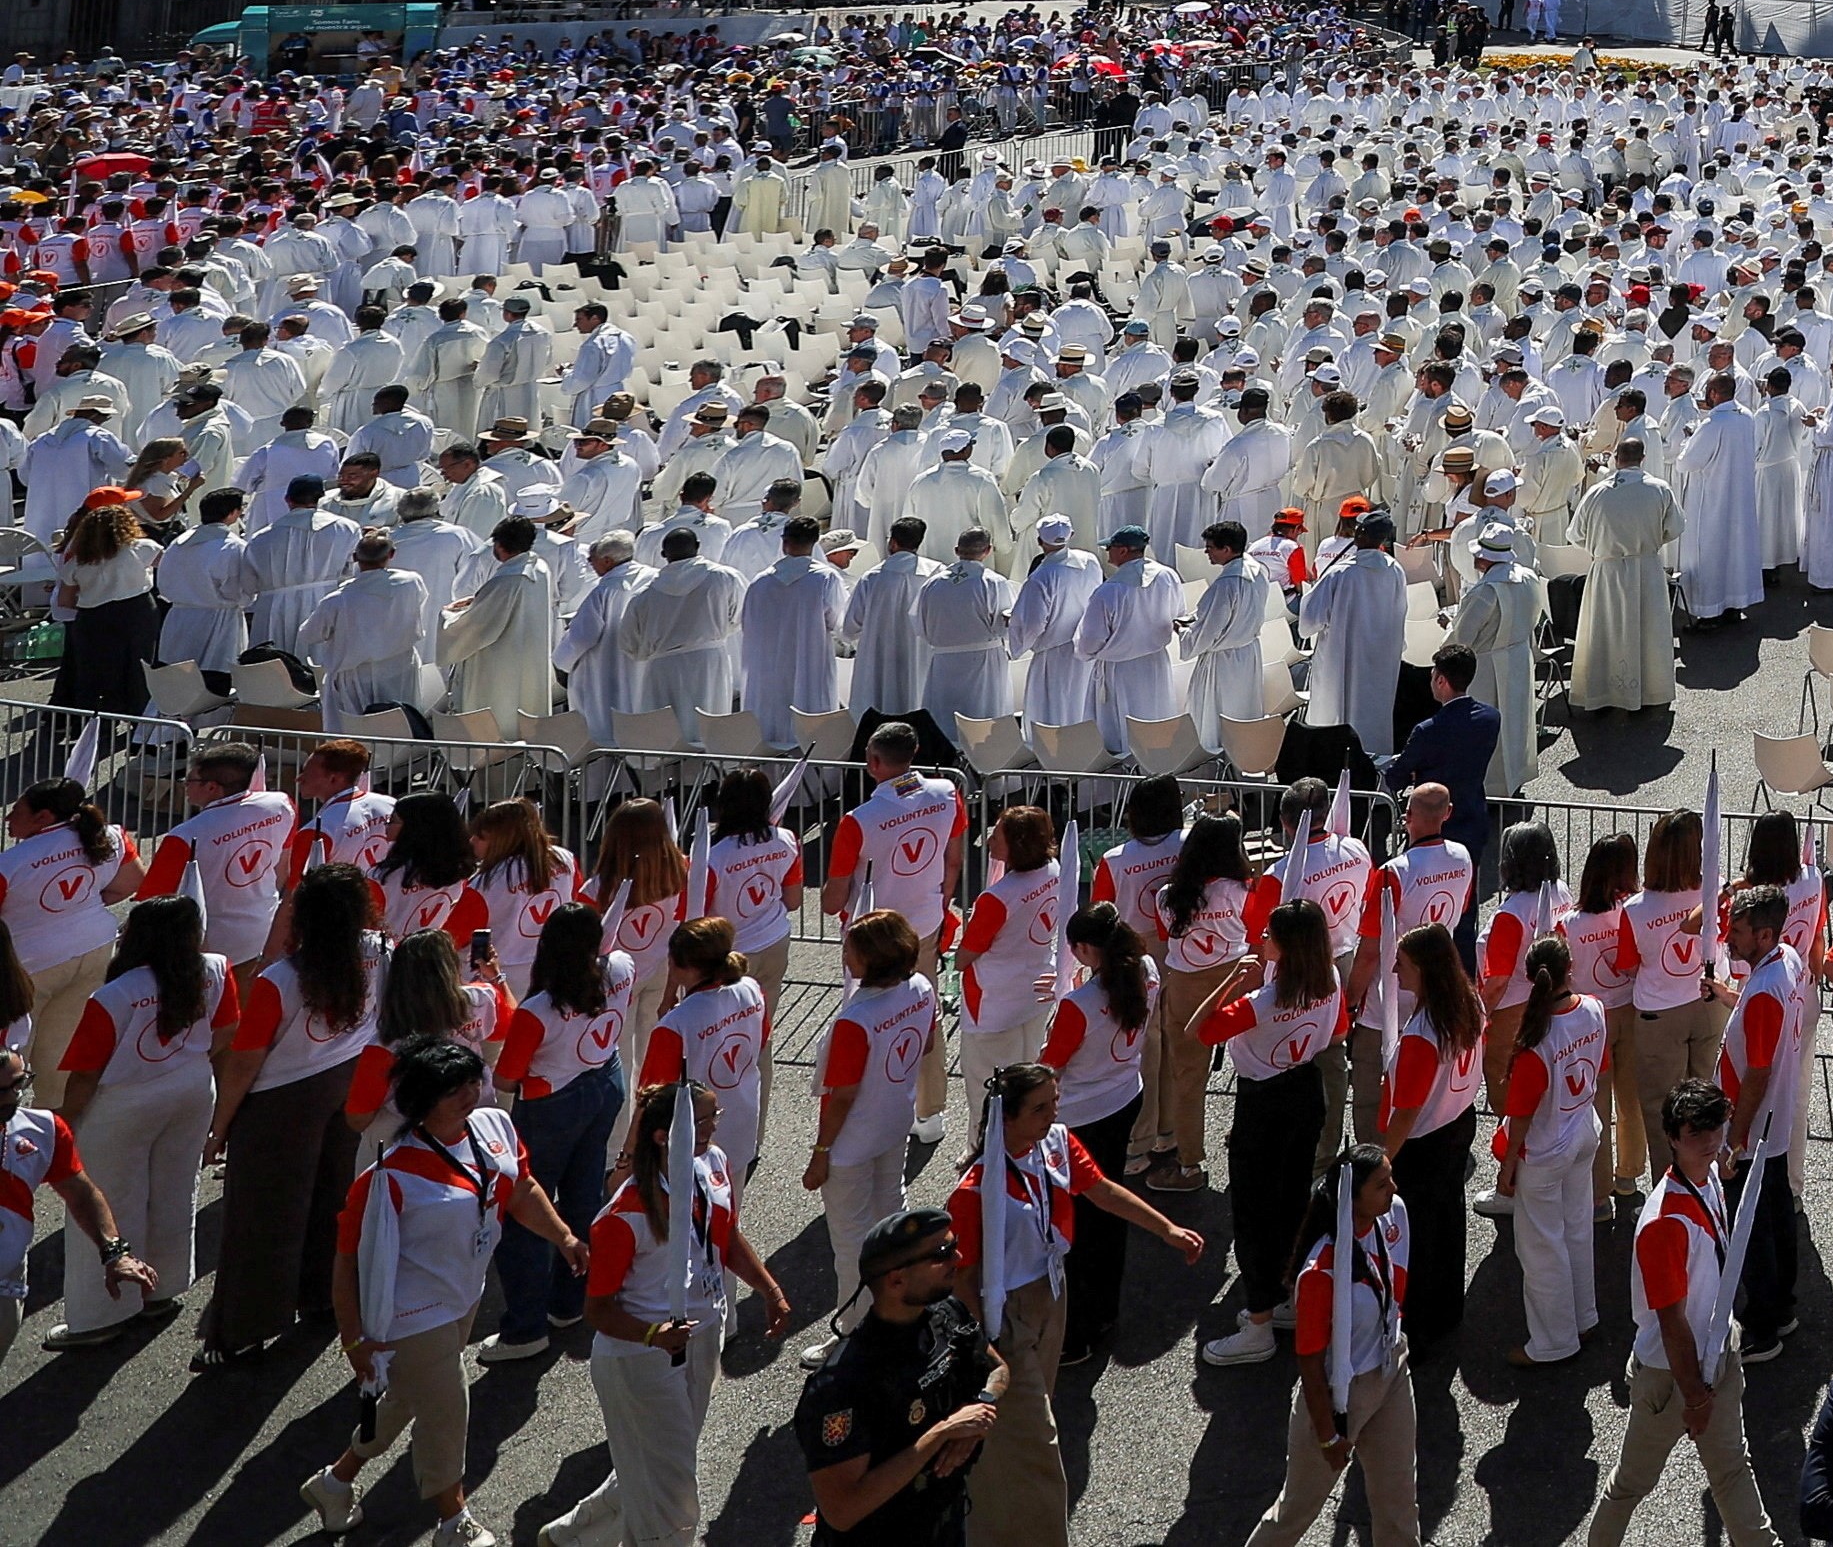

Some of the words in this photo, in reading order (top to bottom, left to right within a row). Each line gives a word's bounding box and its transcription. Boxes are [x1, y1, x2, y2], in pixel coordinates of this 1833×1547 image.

[878, 801, 946, 831] VOLUNTARIO
[212, 814, 283, 846] VOLUNTARIO
[31, 846, 83, 869] VOLUNT
[238, 849, 263, 876] V
[725, 850, 788, 874] VOLUNTARIO
[901, 837, 924, 864] V
[1303, 857, 1362, 886] VOLUNTARIO
[58, 875, 84, 901] V
[746, 884, 767, 906] V
[1021, 877, 1059, 904] VOLUNTA
[419, 903, 443, 928] V
[528, 898, 554, 926] V
[1328, 893, 1348, 917] V
[1429, 902, 1445, 923] V
[630, 914, 651, 939] V
[1647, 908, 1695, 930] VOLUNT
[1191, 934, 1214, 956] V
[1579, 928, 1620, 945] VOLUNT
[1672, 938, 1694, 964] V
[874, 997, 930, 1033] VOLUNTARIO
[591, 1020, 617, 1051] V
[723, 1044, 741, 1074] V
[1289, 1035, 1312, 1064] V
[1565, 1069, 1585, 1096] V
